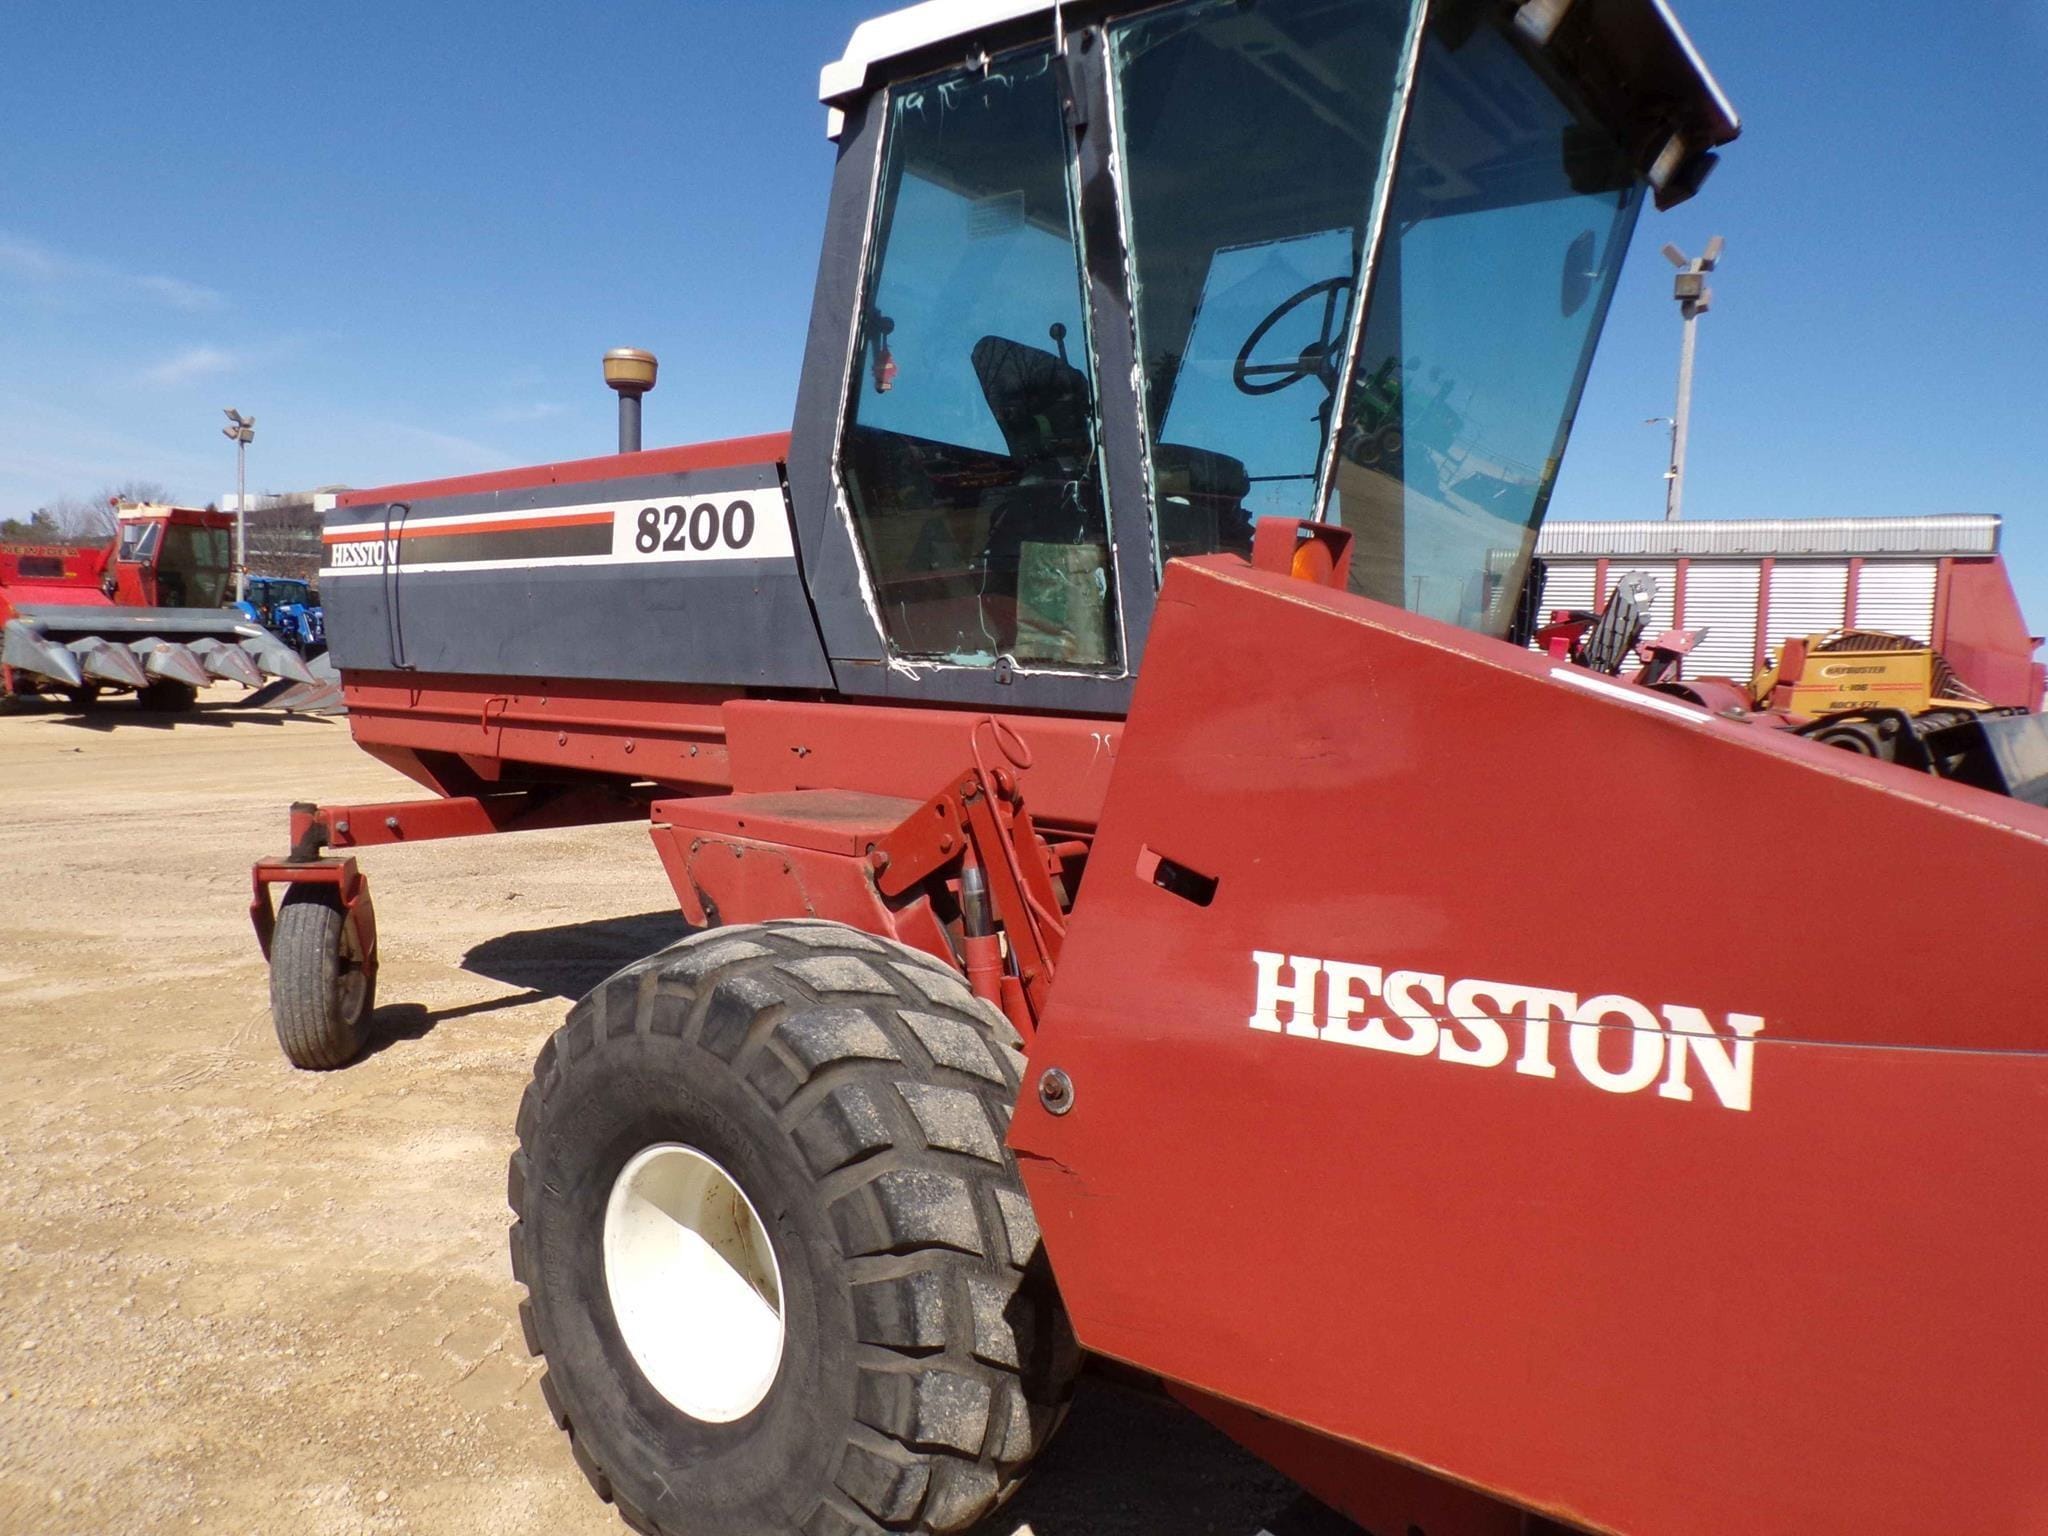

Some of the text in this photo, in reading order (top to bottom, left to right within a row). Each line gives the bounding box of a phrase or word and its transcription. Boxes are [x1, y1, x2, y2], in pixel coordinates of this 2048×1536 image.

[331, 539, 399, 568] HESSTON
[636, 500, 755, 554] 8200
[1249, 950, 1765, 1112] HESSTON
